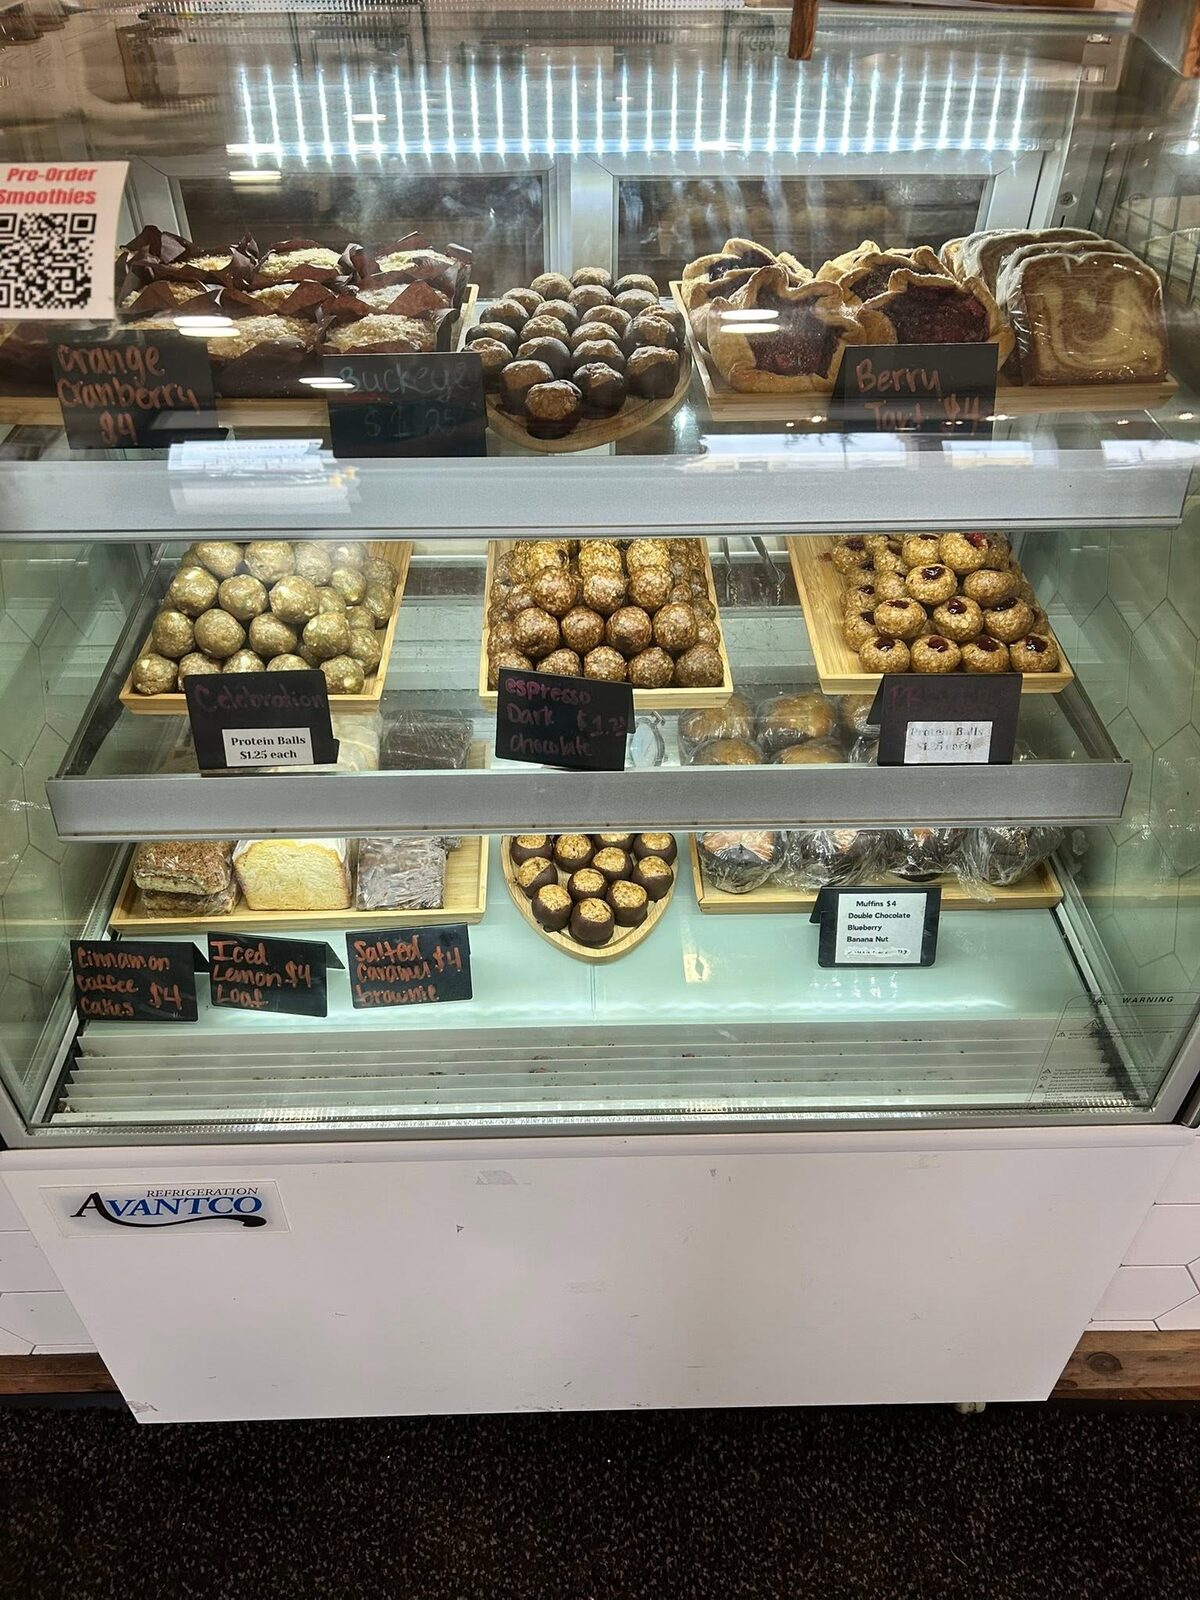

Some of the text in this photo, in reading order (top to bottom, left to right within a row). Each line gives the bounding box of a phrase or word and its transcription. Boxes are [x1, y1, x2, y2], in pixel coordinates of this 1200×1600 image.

[7, 168, 97, 182] Pre-Order
[0, 189, 96, 204] Smoothies
[856, 358, 943, 402] Berry
[364, 404, 457, 437] $125
[231, 735, 306, 746] Protein Balls
[240, 749, 297, 760] $1.25 each
[847, 924, 882, 932] Blueberry
[210, 941, 268, 966] Iced
[354, 934, 423, 963] Salted
[213, 964, 281, 987] Lemon
[1122, 996, 1174, 1004] WARNING
[146, 1187, 259, 1198] REFRIGERATION
[70, 1191, 264, 1222] AVANTCO
